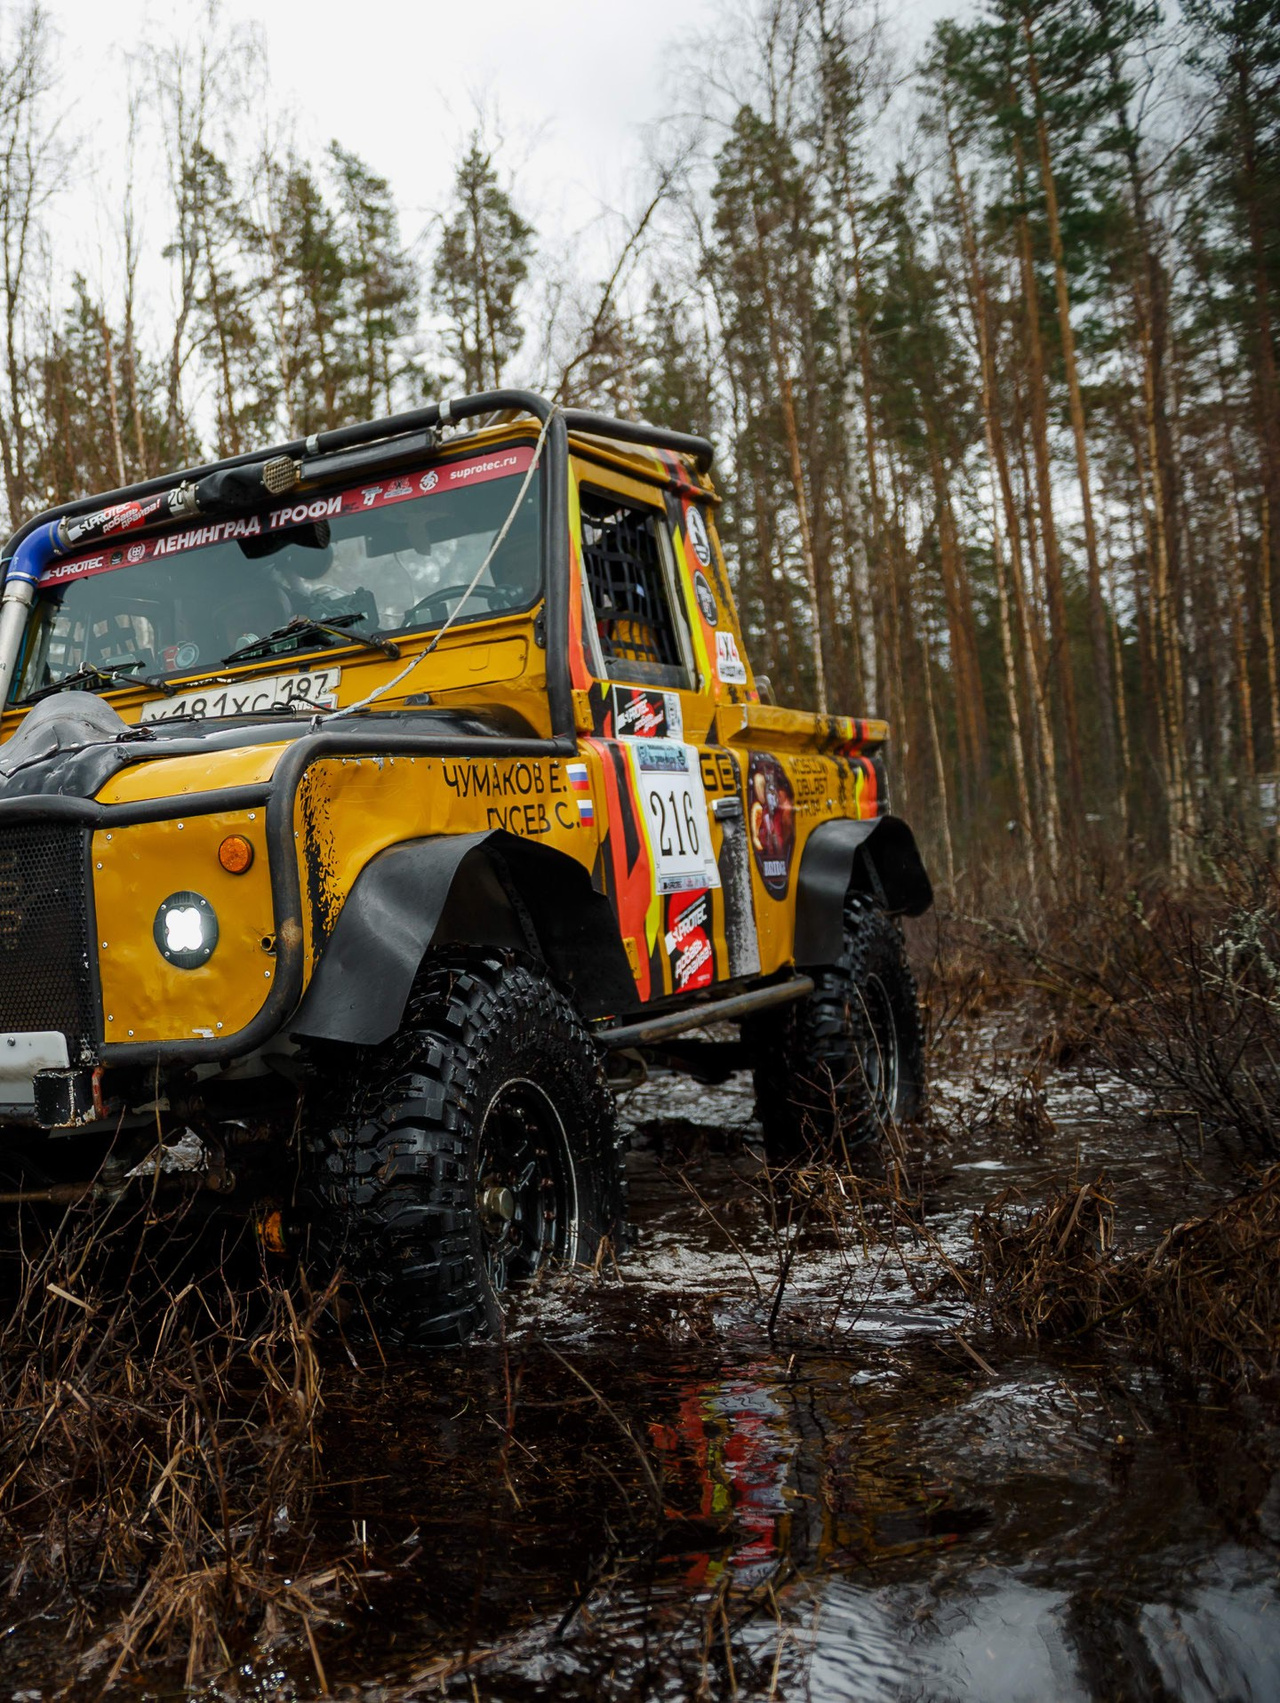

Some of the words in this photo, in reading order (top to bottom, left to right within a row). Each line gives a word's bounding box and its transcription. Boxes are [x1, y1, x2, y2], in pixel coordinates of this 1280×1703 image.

[450, 454, 518, 481] suprotec.ru
[78, 501, 132, 531] SUPROTEC
[153, 516, 262, 556] ЛЕНИНГРАД
[268, 495, 343, 529] ТРОФИ
[49, 556, 104, 578] SUPROTEC
[280, 673, 329, 700] 197
[442, 763, 545, 797] ЧУМАКОВ
[549, 763, 568, 793] Е.
[486, 803, 552, 836] ГУСЕВ
[554, 801, 581, 830] С.
[650, 790, 700, 857] 216
